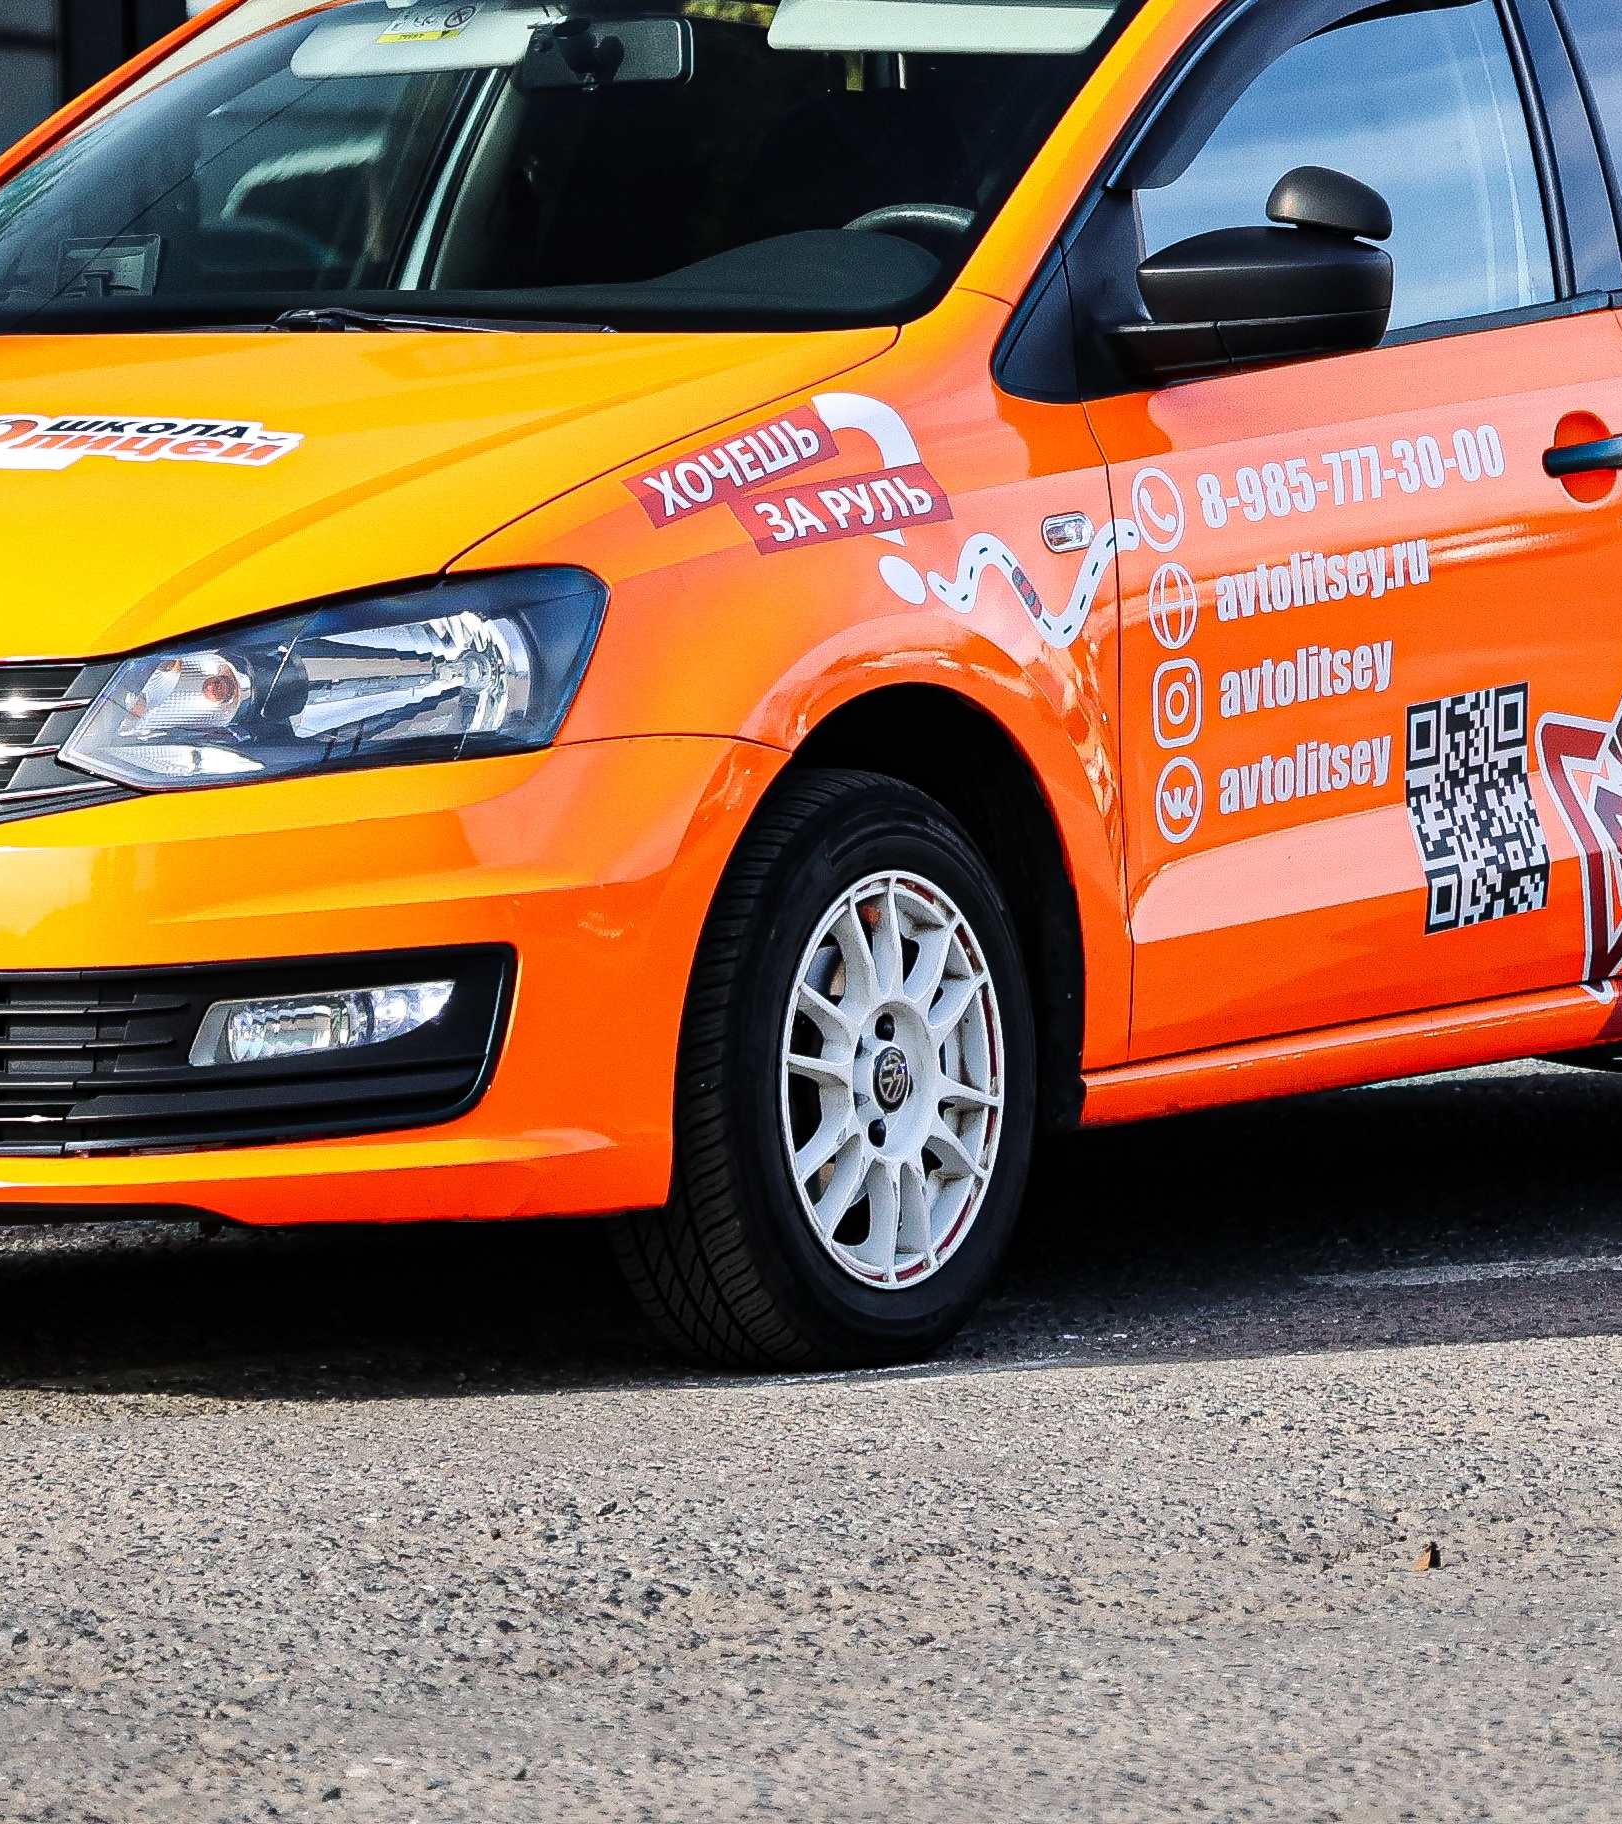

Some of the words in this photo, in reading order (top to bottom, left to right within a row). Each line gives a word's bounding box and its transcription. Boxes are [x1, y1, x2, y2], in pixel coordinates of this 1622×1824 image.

[7, 433, 289, 461] лицей
[43, 419, 251, 439] ШКОЛА
[642, 419, 822, 519] ХОЧЕШЬ
[753, 498, 828, 544] ЗА
[820, 476, 935, 529] РУЛЬ
[1195, 424, 1506, 530] 8-985-777-30-00
[1215, 538, 1431, 623] avtolitsey.ru
[1218, 640, 1394, 719] avtolitsey
[1218, 735, 1393, 816] avtolitsey
